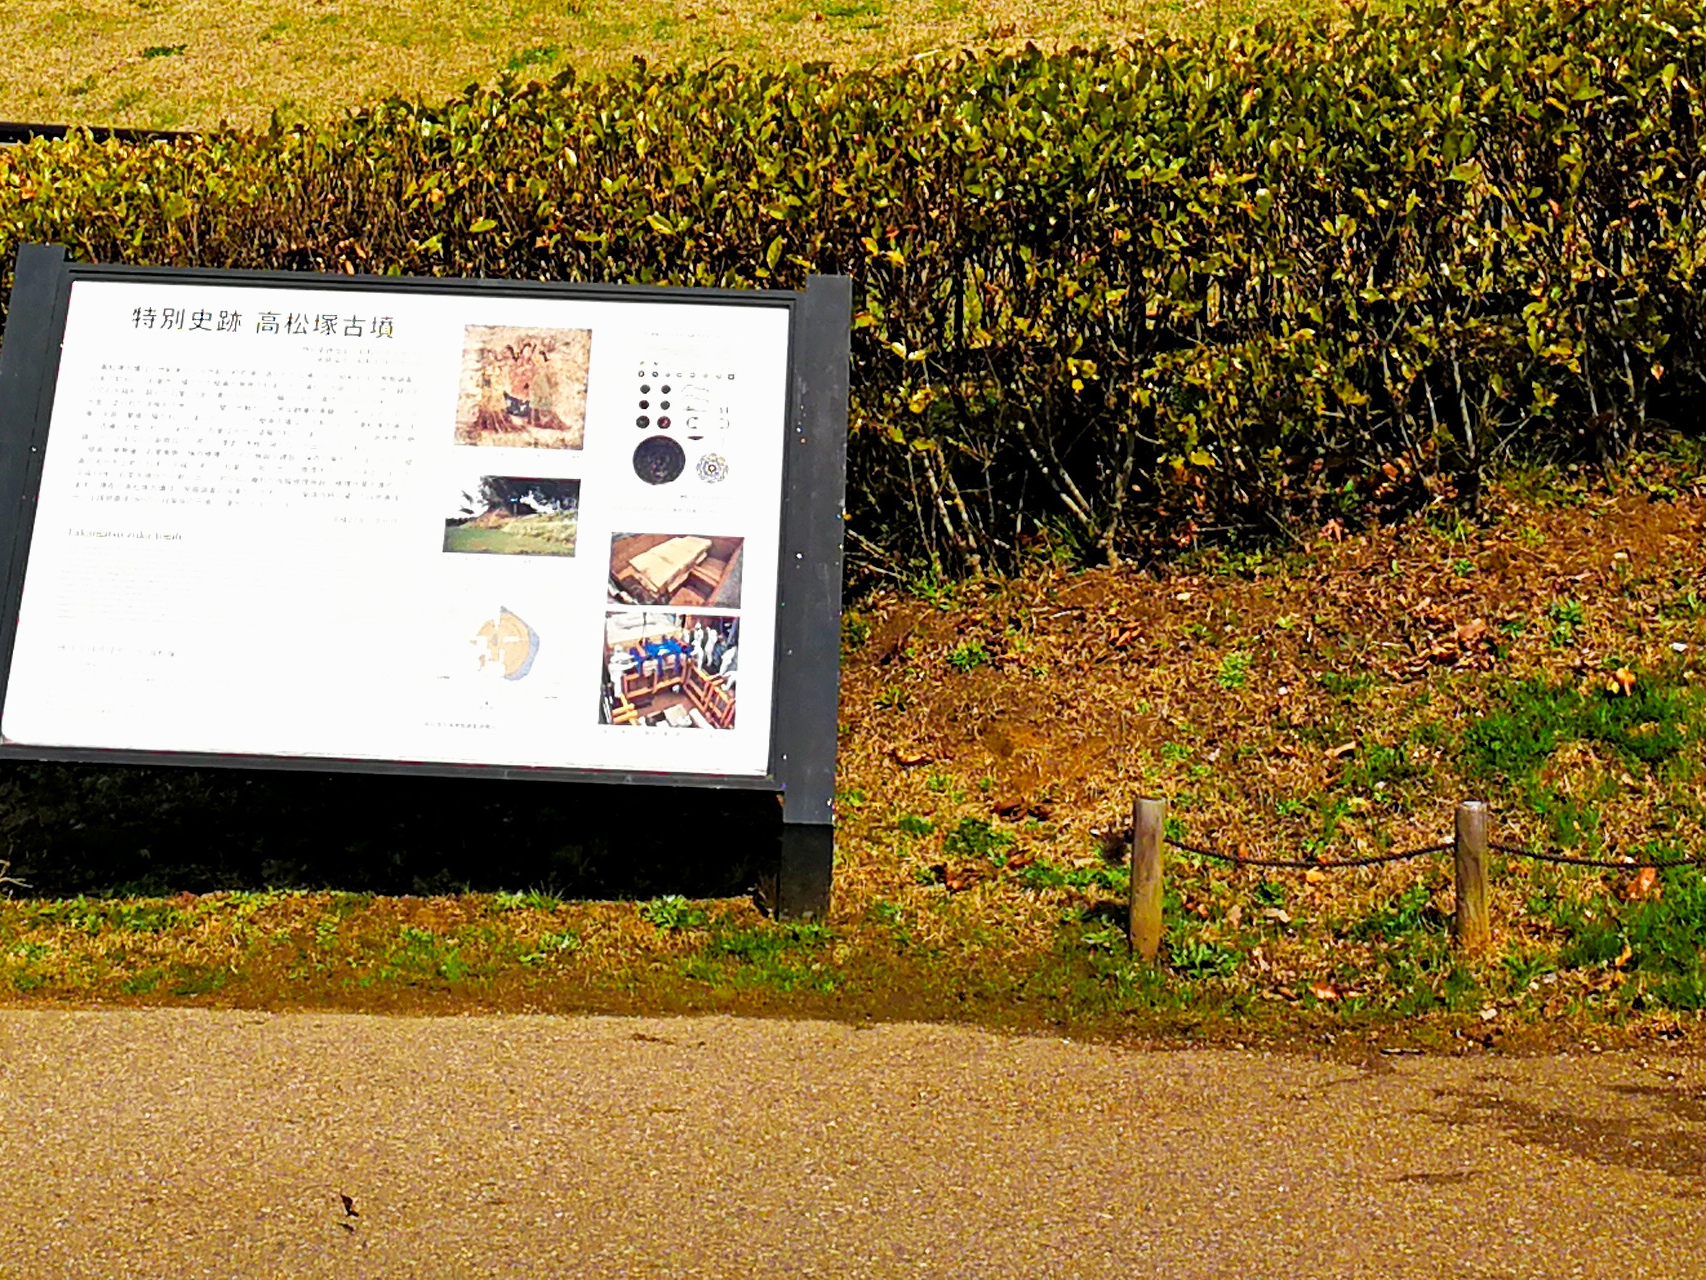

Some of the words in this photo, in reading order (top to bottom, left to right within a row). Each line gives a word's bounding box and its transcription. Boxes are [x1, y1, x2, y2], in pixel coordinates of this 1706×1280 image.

[132, 306, 243, 333] 特別史跡
[256, 311, 394, 339] 高松塚古墳
